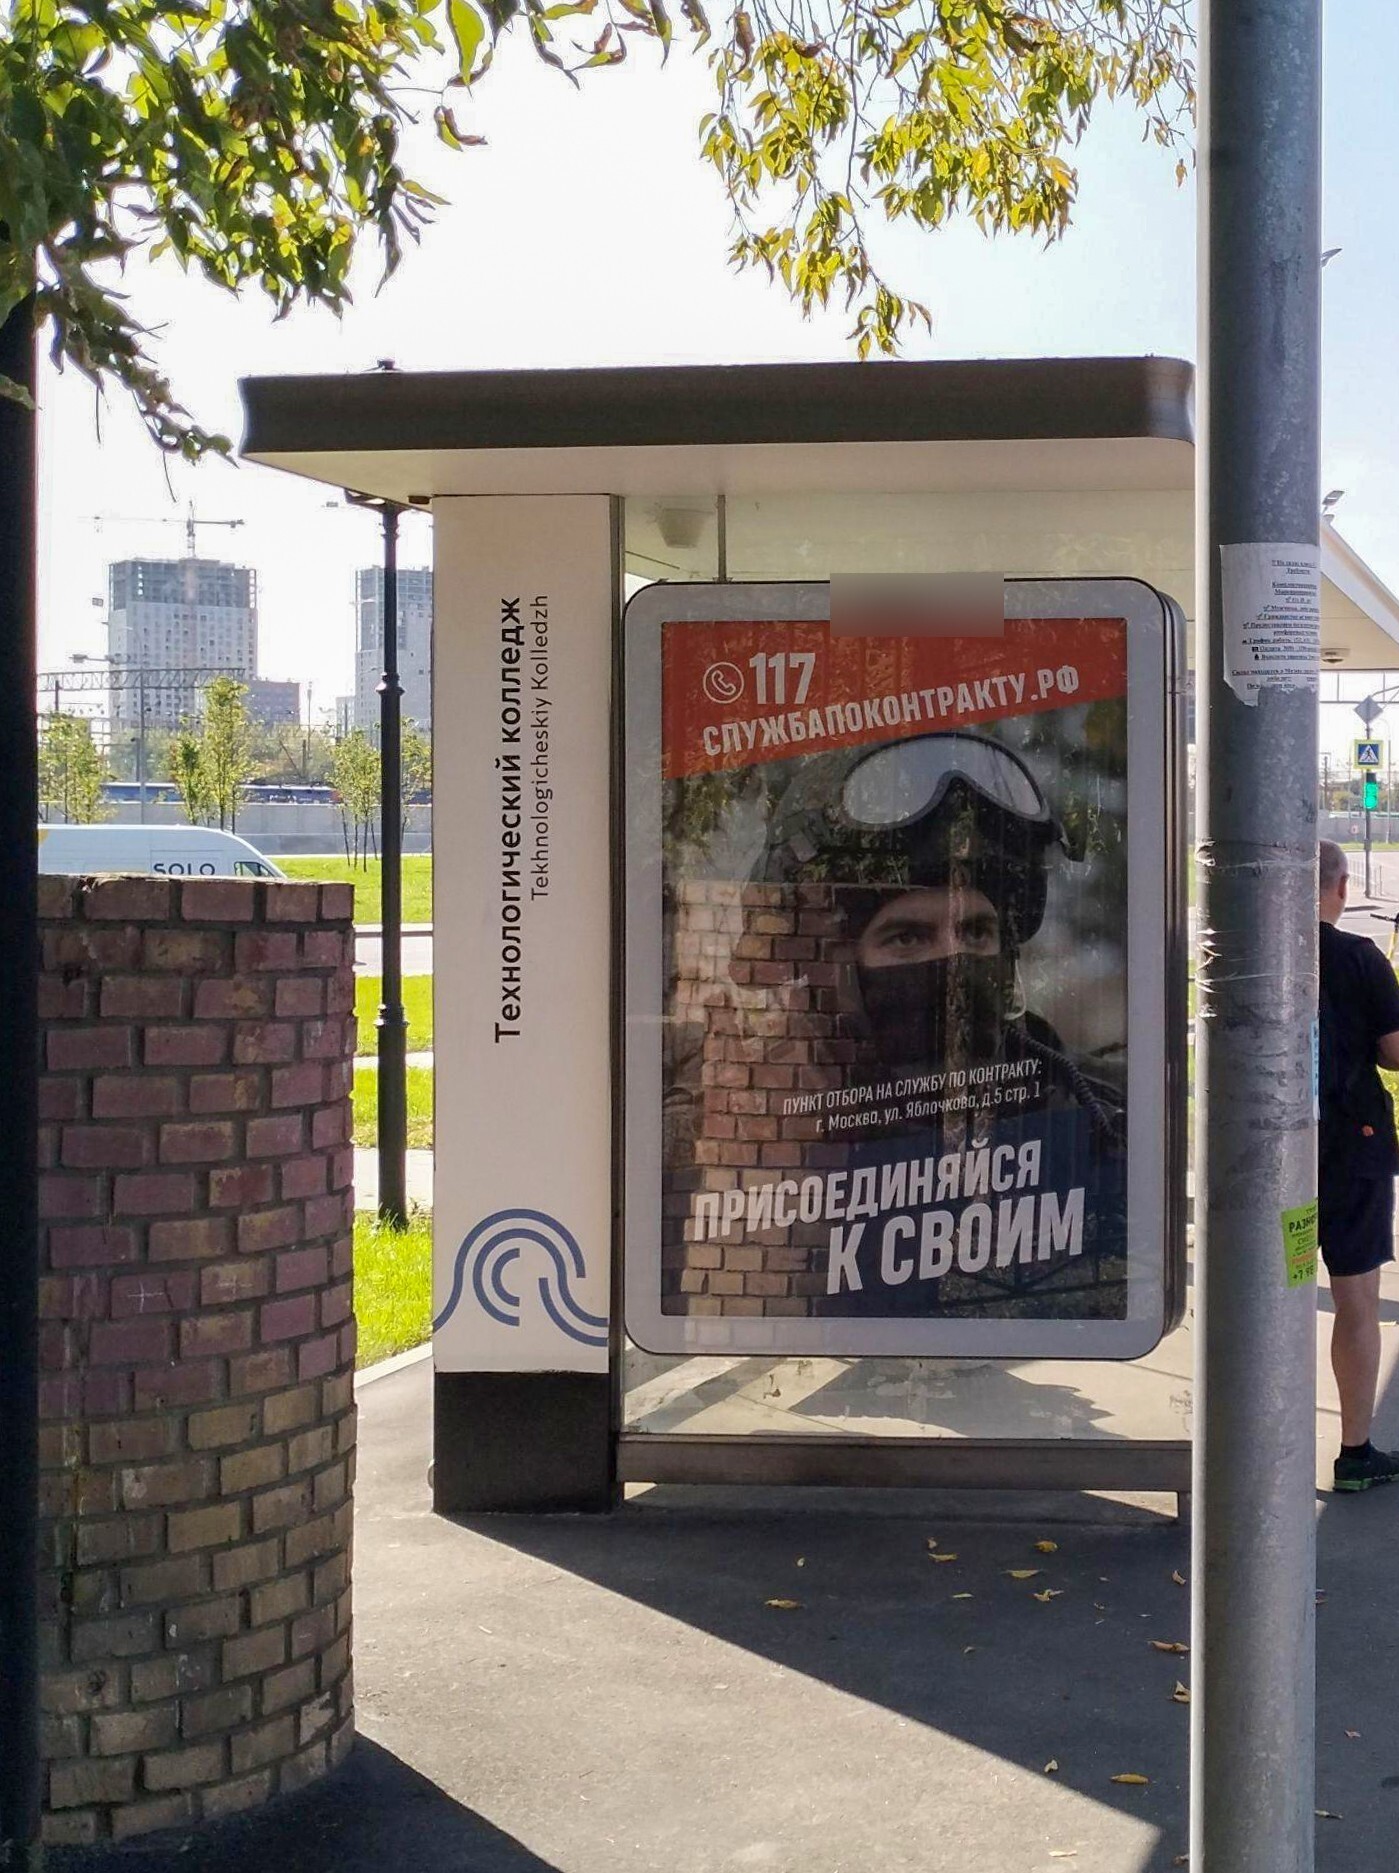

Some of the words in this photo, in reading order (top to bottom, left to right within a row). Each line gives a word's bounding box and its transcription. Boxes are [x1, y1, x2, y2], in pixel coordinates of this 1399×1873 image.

[501, 597, 525, 744] колледж
[530, 594, 549, 693] Kolledzh
[749, 652, 816, 705] 117
[702, 664, 1080, 757] СЛУЖБАПОКОНТРАКТУ.РФ
[530, 701, 554, 901] Tekhnologicheskiy
[495, 757, 521, 1043] Технологический
[783, 1093, 824, 1115] ПУНКТ
[826, 1085, 874, 1108] ОТБОРА
[876, 1083, 892, 1101] НА
[895, 1073, 948, 1097] СЛУЖБУ
[949, 1070, 966, 1088] ПО
[968, 1058, 1043, 1085] КОНТРАКТУ:
[1033, 1081, 1041, 1098] 1
[692, 1138, 1042, 1242] ПРИСОЕДИНЯЙСЯ
[826, 1221, 866, 1296] К
[880, 1186, 1086, 1287] СВОИМ
